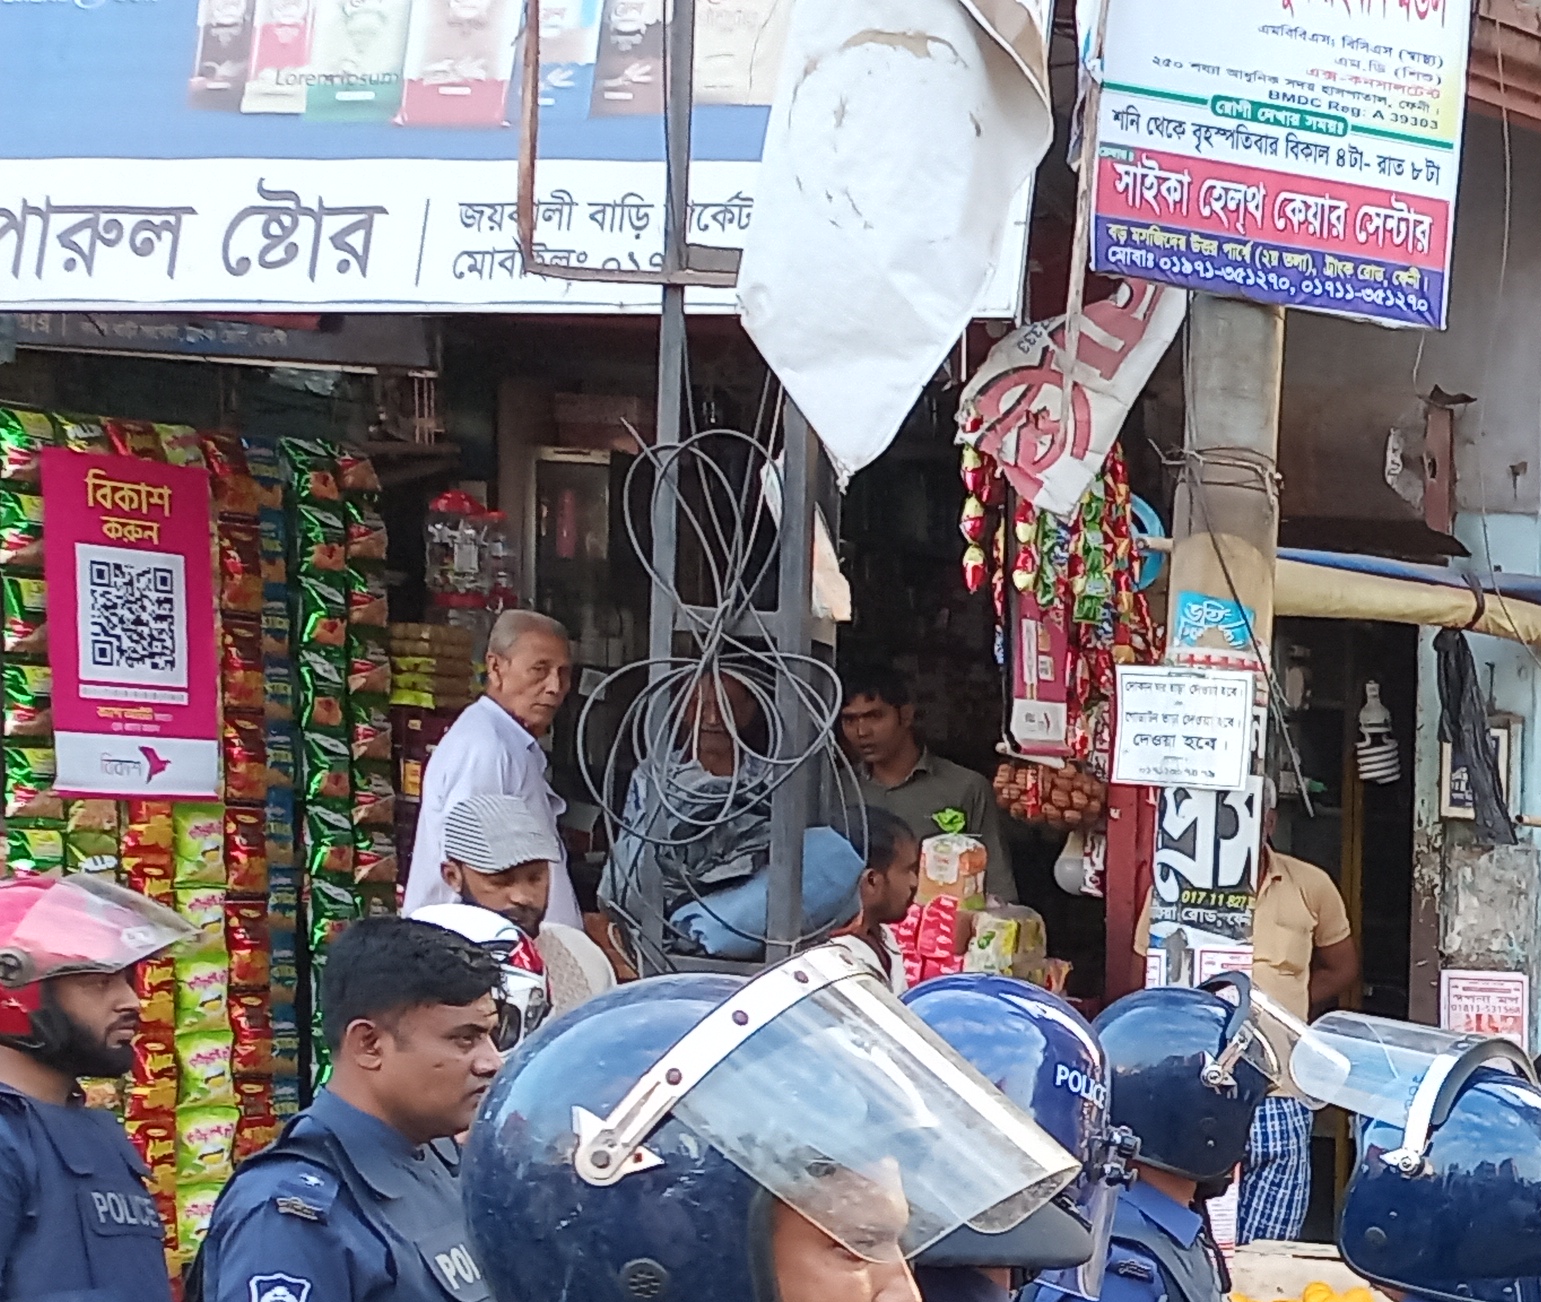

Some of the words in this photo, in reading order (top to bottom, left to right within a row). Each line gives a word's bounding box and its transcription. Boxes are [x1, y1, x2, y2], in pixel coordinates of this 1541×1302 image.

[1152, 55, 1184, 70] ২৫০
[1268, 89, 1322, 110] BMDC
[1327, 100, 1366, 119] Reg:
[1372, 109, 1386, 122] A
[1389, 113, 1440, 131] 39303
[1111, 104, 1140, 134] শনি
[1146, 116, 1187, 141] থেকে
[1190, 123, 1280, 157] বৃহস্পতিবার
[1285, 131, 1331, 167] বিকাল
[1376, 154, 1406, 180] রাত
[1411, 158, 1442, 187] ৮টা
[586, 192, 654, 240] বাড়ি
[1113, 154, 1192, 218] সাইকা
[1198, 177, 1266, 236] হেল্থ
[1272, 189, 1349, 242] কেয়ার
[1355, 199, 1434, 256] সেন্টার
[0, 195, 198, 280] পারুল
[222, 177, 389, 283] ষ্টোর
[83, 468, 173, 518] বিকাশ
[101, 515, 161, 545] করুন
[1132, 733, 1177, 749] দেওয়া
